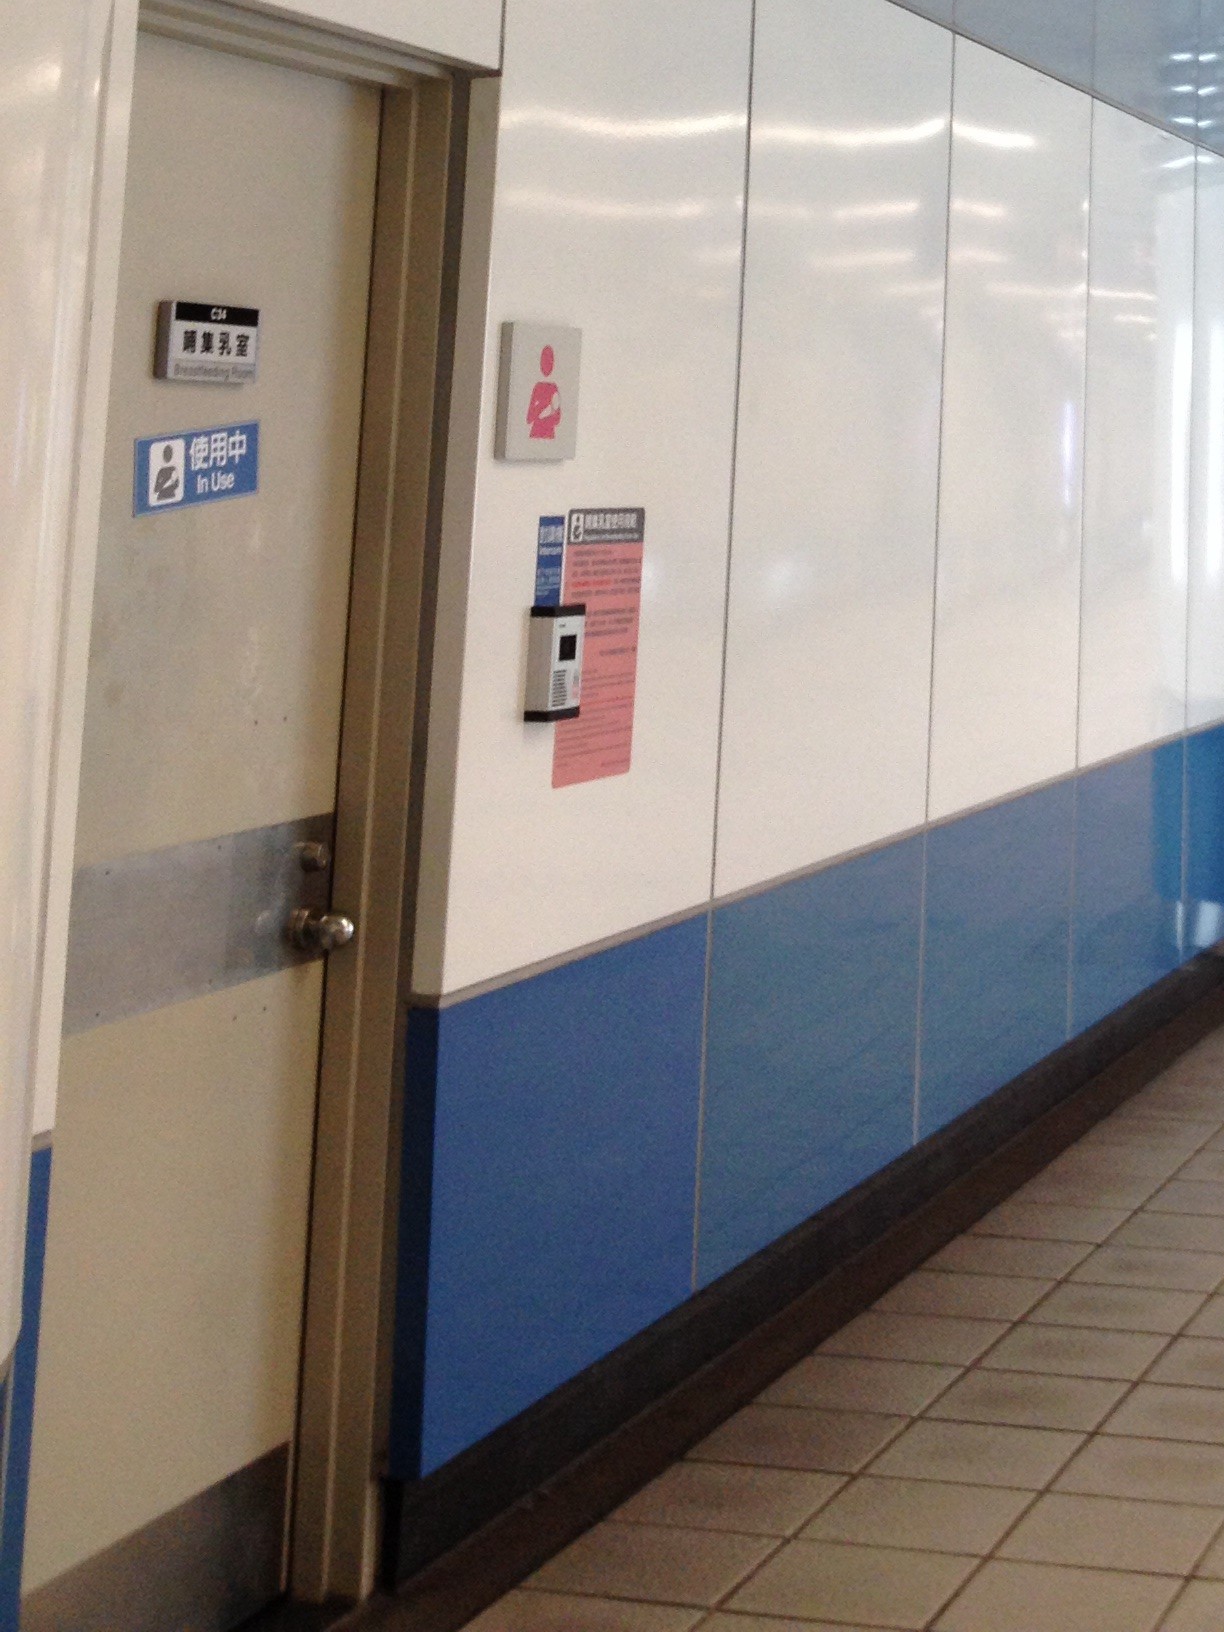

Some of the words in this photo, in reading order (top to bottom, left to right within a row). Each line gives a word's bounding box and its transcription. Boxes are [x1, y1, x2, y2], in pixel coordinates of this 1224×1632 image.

[190, 429, 247, 471] 使用中
[197, 474, 209, 494] In
[211, 471, 235, 491] Use
